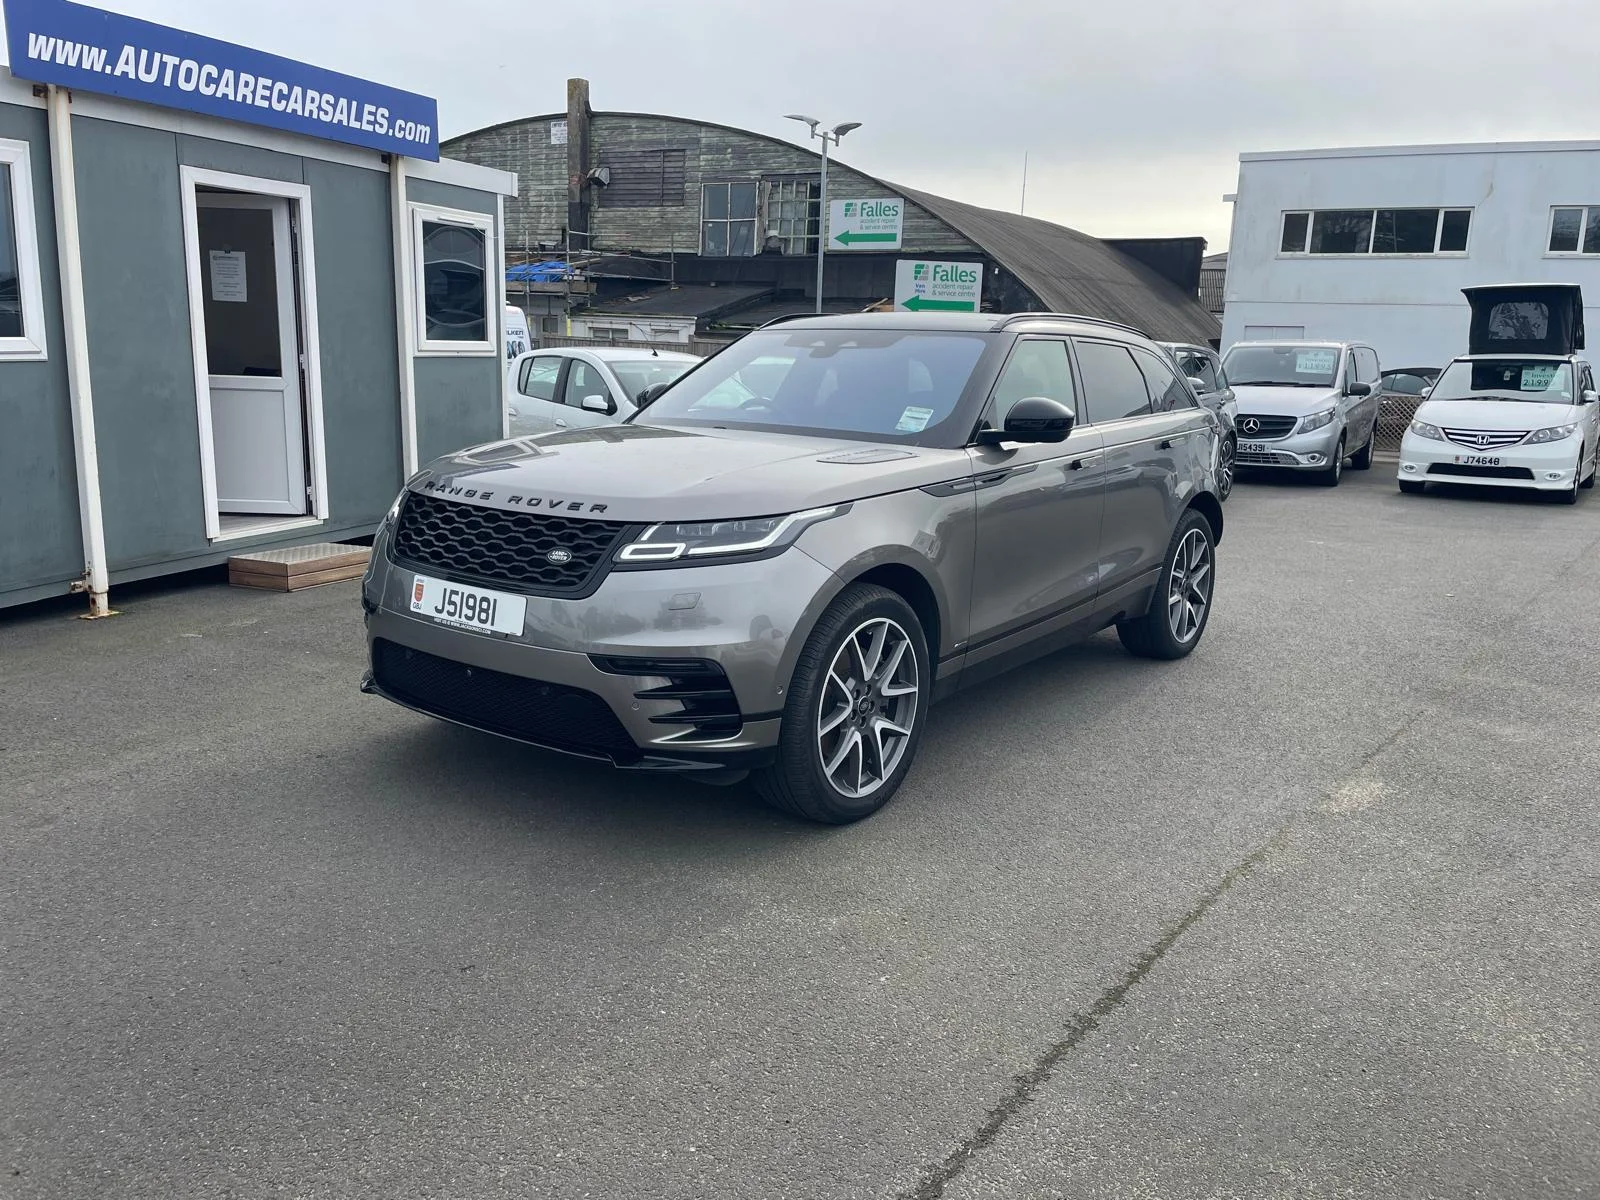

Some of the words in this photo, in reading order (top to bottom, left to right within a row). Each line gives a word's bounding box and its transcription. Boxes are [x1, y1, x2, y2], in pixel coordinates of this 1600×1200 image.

[28, 32, 431, 145] www.AUTOCARECARSALES.com
[860, 202, 898, 217] Falles
[933, 265, 977, 283] Falles
[1463, 456, 1500, 466] J74648
[424, 481, 494, 500] RANGE
[508, 495, 608, 513] ROVER
[434, 588, 497, 627] J51981
